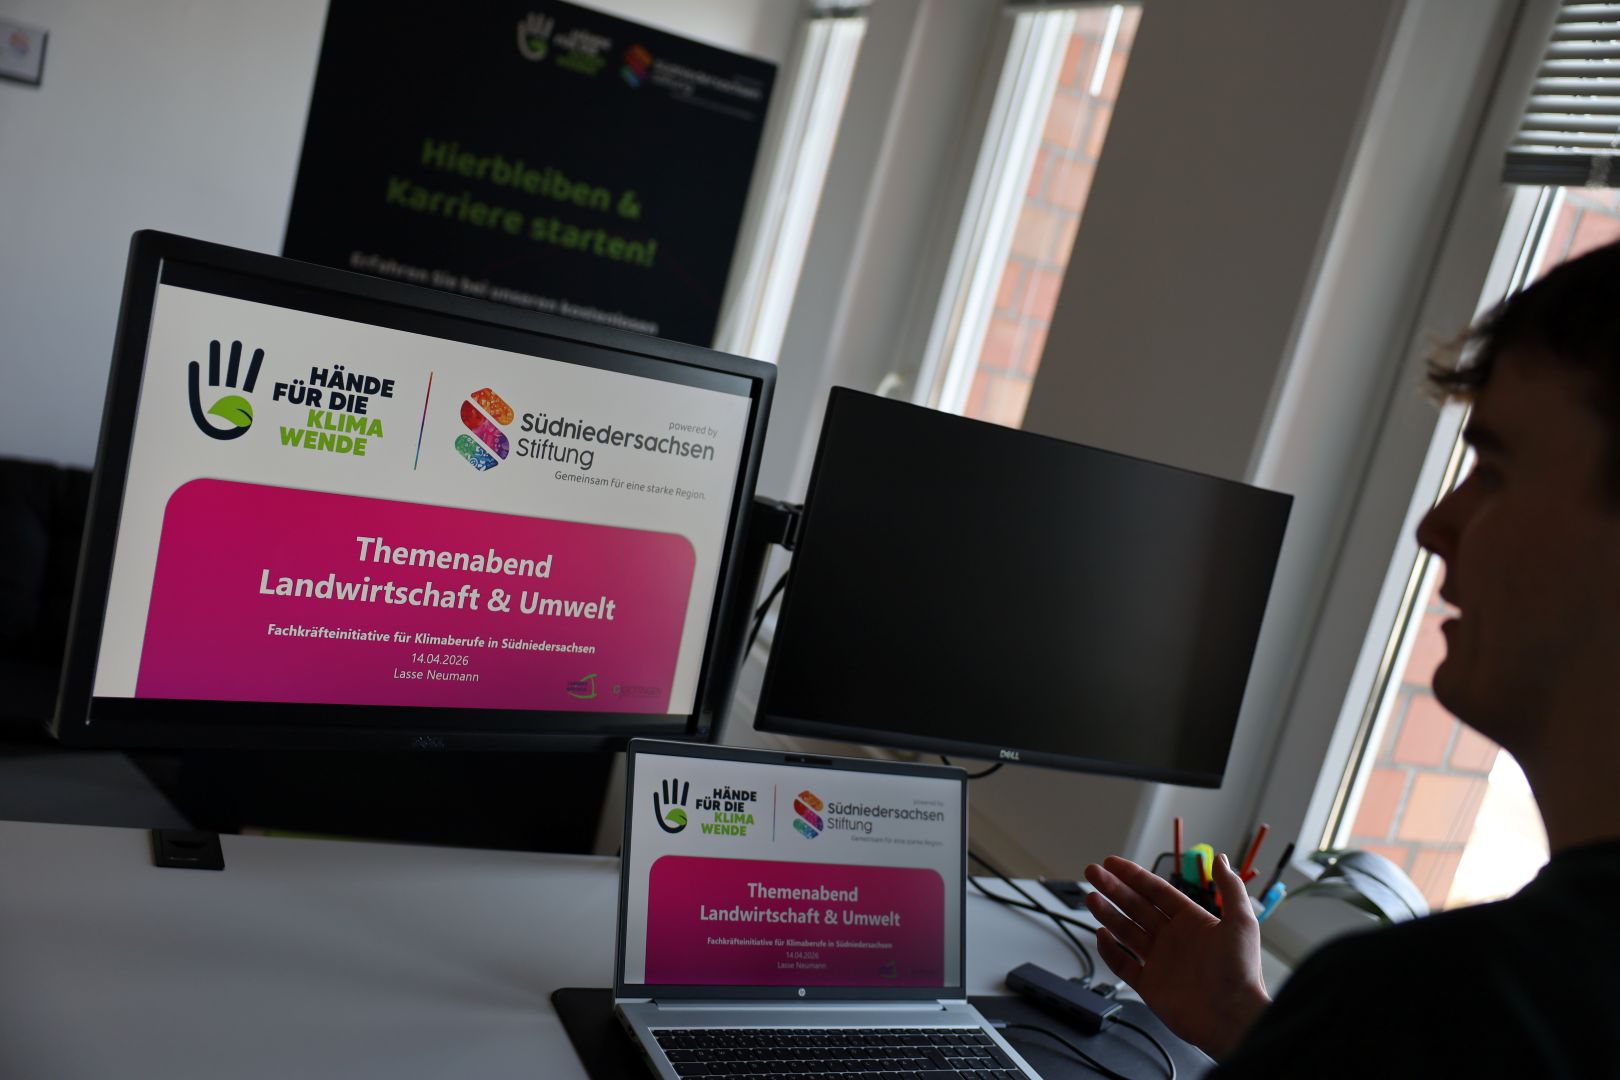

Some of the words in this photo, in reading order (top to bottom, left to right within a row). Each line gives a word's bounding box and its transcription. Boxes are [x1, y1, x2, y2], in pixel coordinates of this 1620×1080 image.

[421, 138, 611, 211] Hierbleiben
[617, 189, 642, 220] &
[386, 176, 524, 235] Karriere
[530, 215, 658, 268] starten!
[350, 251, 428, 282] Erfahren
[432, 269, 457, 289] Sie
[460, 274, 488, 294] bei
[309, 364, 395, 399] HÄNDE
[273, 379, 323, 408] FÜR
[328, 392, 369, 415] DIE
[307, 408, 384, 438] KLIMA
[669, 421, 706, 435] powered
[707, 427, 719, 438] by
[279, 426, 368, 457] WENDE
[520, 412, 715, 461] Südniedersachsen
[516, 437, 595, 471] Stiftung
[554, 470, 609, 487] Gemeinsam
[610, 477, 625, 489] für
[626, 480, 645, 492] eine
[646, 482, 674, 496] starke
[675, 487, 706, 501] Region.
[356, 536, 553, 580] Themenabend
[259, 568, 481, 611] Landwirtschaft
[487, 587, 511, 613] &
[519, 590, 616, 621] Umwelt
[267, 623, 390, 644] Fachkräfteinitiative
[393, 630, 412, 644] für
[414, 632, 485, 649] Klimaberufe
[487, 636, 498, 649] in
[501, 637, 596, 654] Südniedersachsen
[411, 653, 469, 667] 14.04.2026
[393, 668, 424, 680] Lasse
[426, 669, 479, 682] Neumann
[1000, 749, 1020, 760] DELL
[695, 796, 721, 811] FÜR
[724, 801, 745, 813] DIE
[713, 786, 757, 802] HÄNDE
[714, 812, 755, 825] KLIMA
[827, 802, 944, 822] Südniedersachsen
[701, 823, 747, 837] WENDE
[827, 817, 873, 834] Stiftung
[747, 882, 859, 902] Themenabend
[700, 905, 820, 925] Landwirtschaft
[824, 909, 838, 925] &
[842, 910, 901, 927] Umwelt
[707, 937, 773, 947] Fachkräfteinitiative
[775, 938, 785, 947] für
[786, 939, 827, 948] Klimaberufe
[828, 939, 834, 947] in
[836, 939, 893, 949] Südniedersachsen
[777, 961, 795, 969] Lasse
[796, 961, 827, 970] Neumann
[786, 951, 820, 960] 14.04.2026
